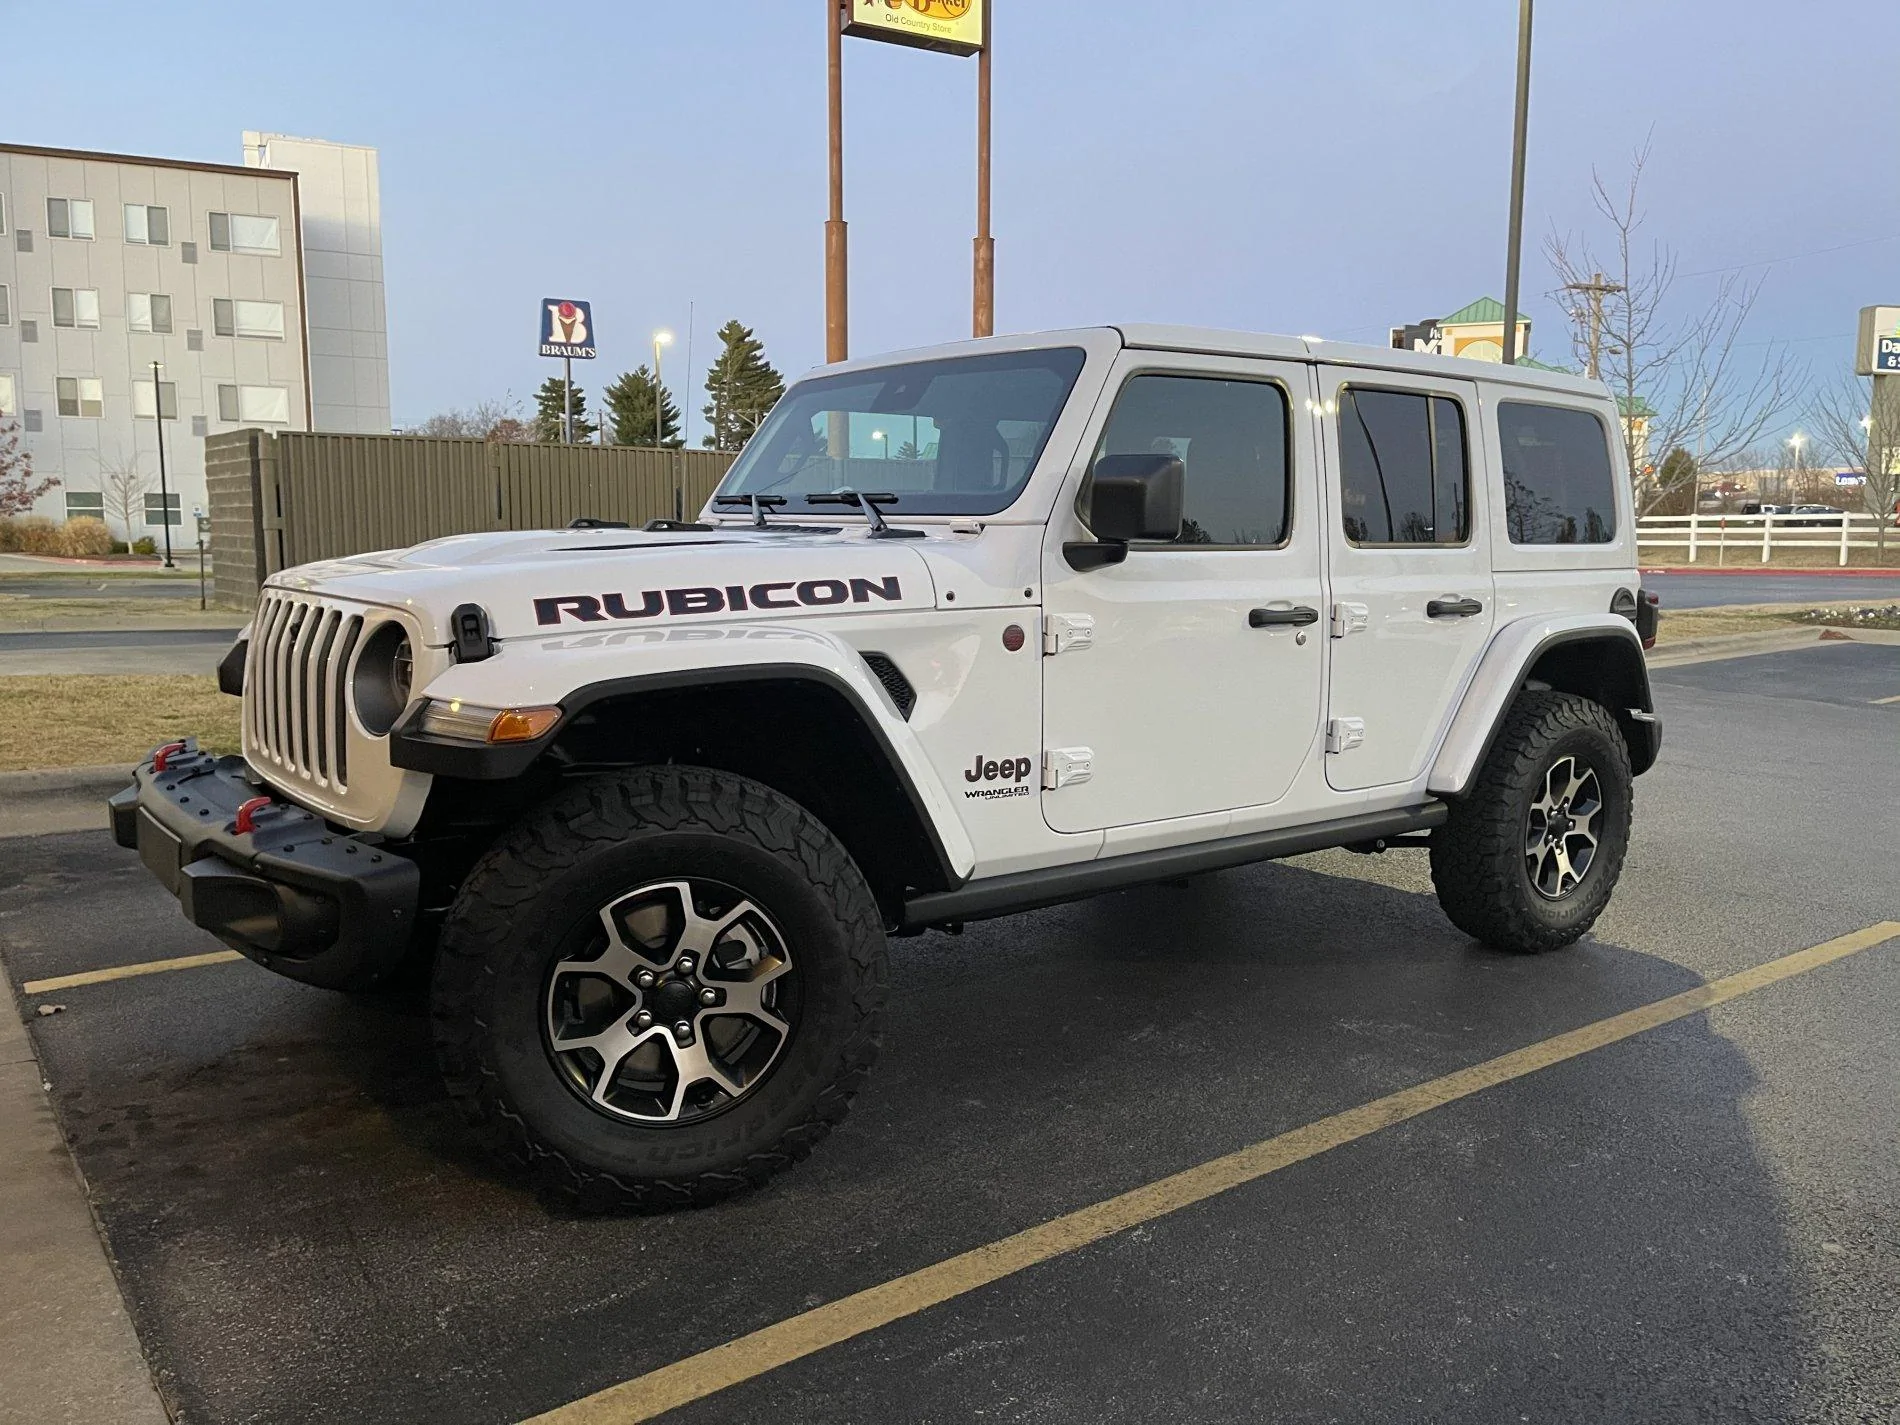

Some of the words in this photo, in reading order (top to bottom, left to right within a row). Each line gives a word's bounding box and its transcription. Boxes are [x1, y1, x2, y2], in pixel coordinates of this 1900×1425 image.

[885, 13, 899, 24] Old
[900, 16, 931, 31] Country
[932, 22, 952, 34] Store
[541, 344, 595, 357] BRAUM'S
[533, 576, 903, 626] RUBICON
[965, 755, 1031, 782] Jeep
[964, 786, 1029, 798] WRANGLER
